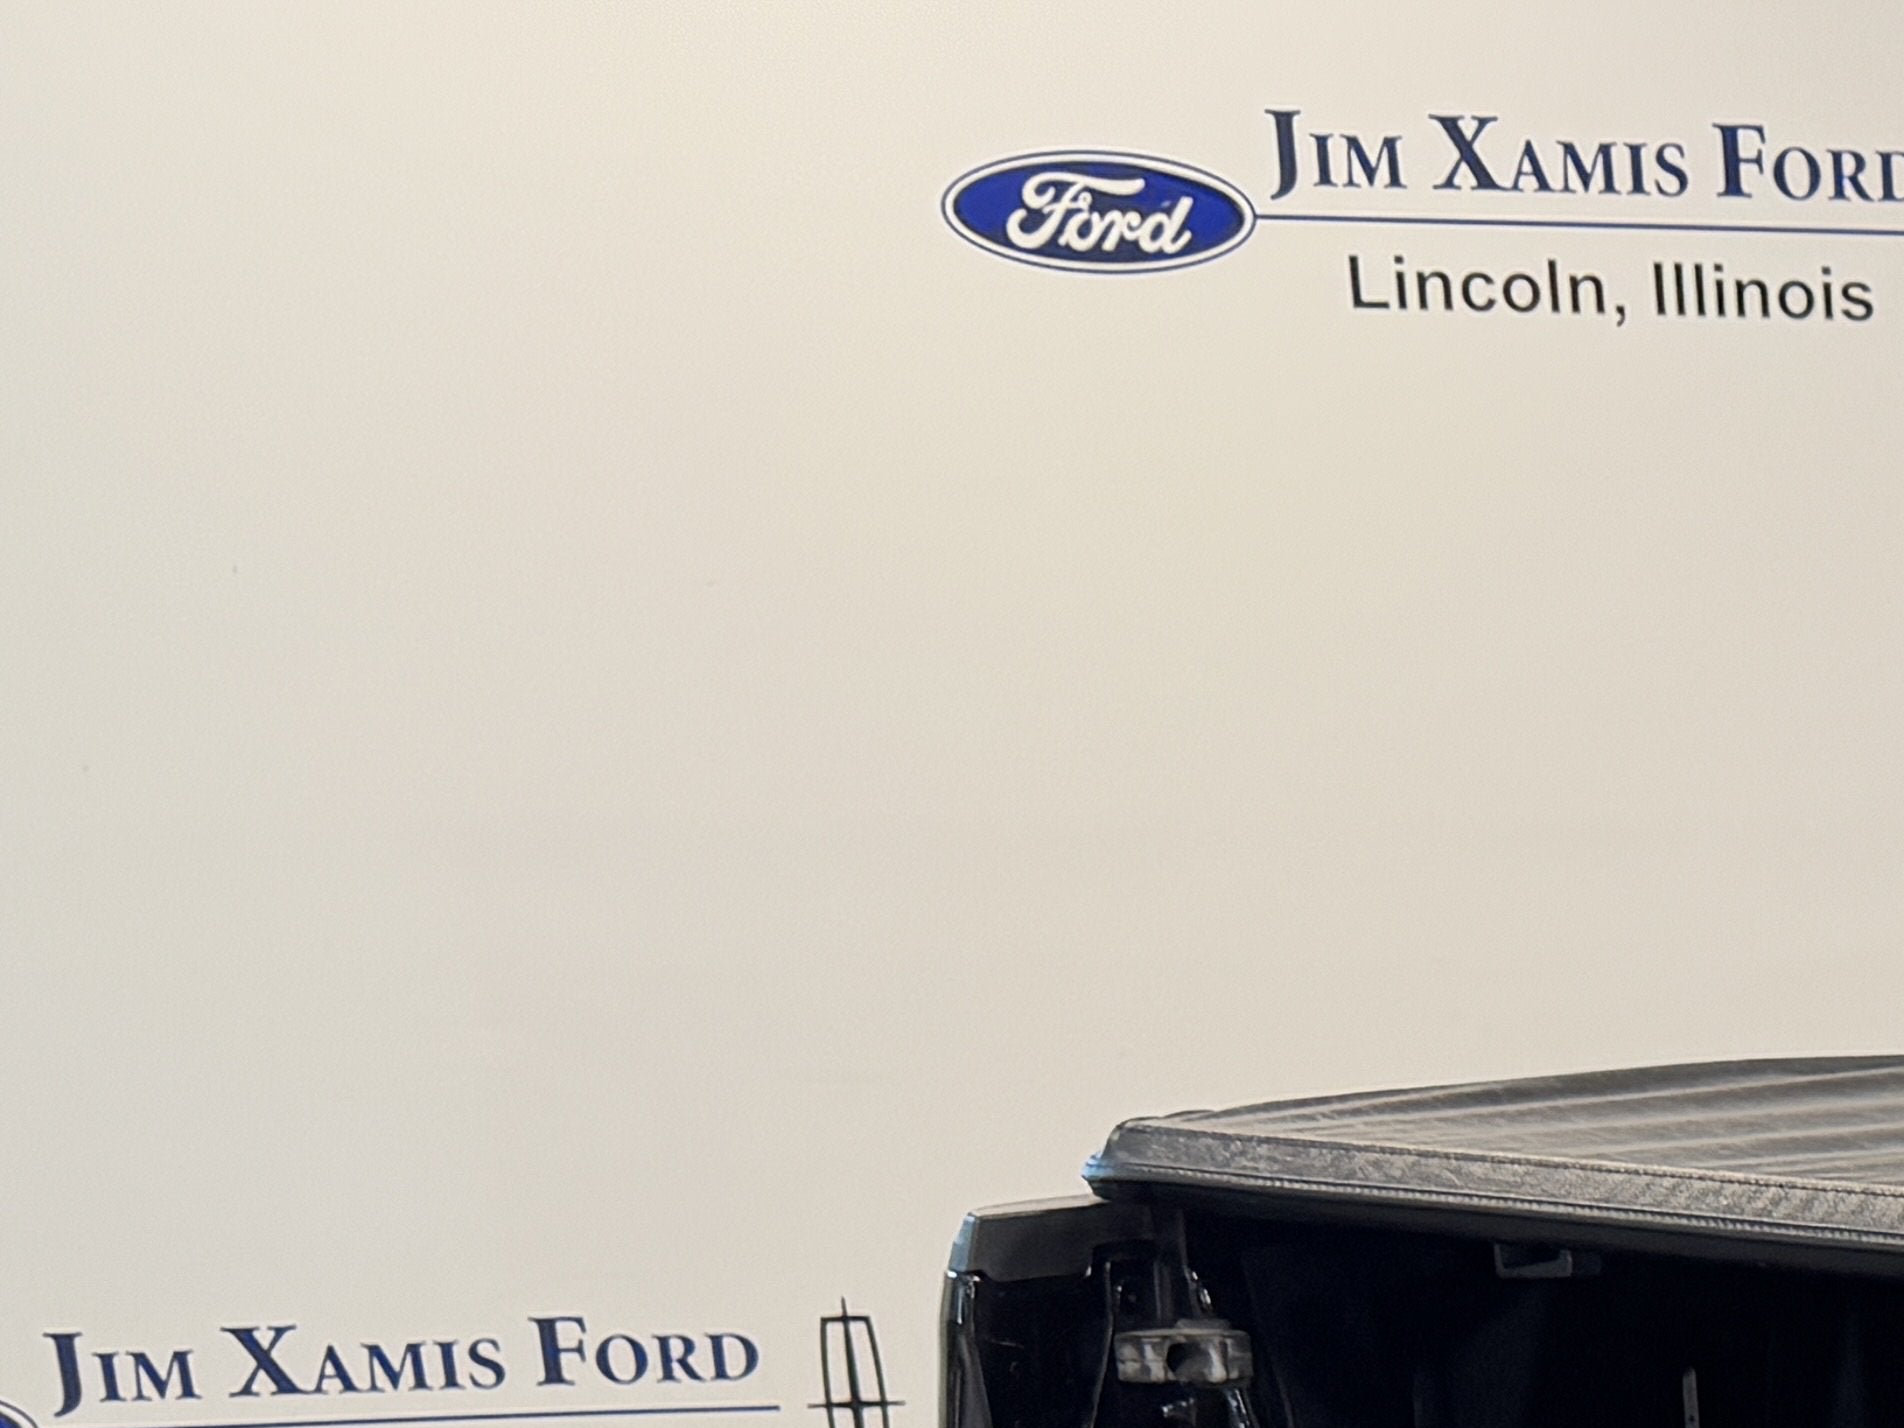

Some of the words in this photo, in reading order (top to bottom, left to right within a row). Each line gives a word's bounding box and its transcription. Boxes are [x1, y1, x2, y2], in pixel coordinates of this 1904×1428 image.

[1427, 113, 1690, 198] XAMIS
[1005, 171, 1194, 254] Ford
[1347, 254, 1627, 328] Lincoln,
[1652, 261, 1875, 323] Illinois
[219, 1323, 507, 1399] XAMIS
[526, 1315, 760, 1388] FORD
